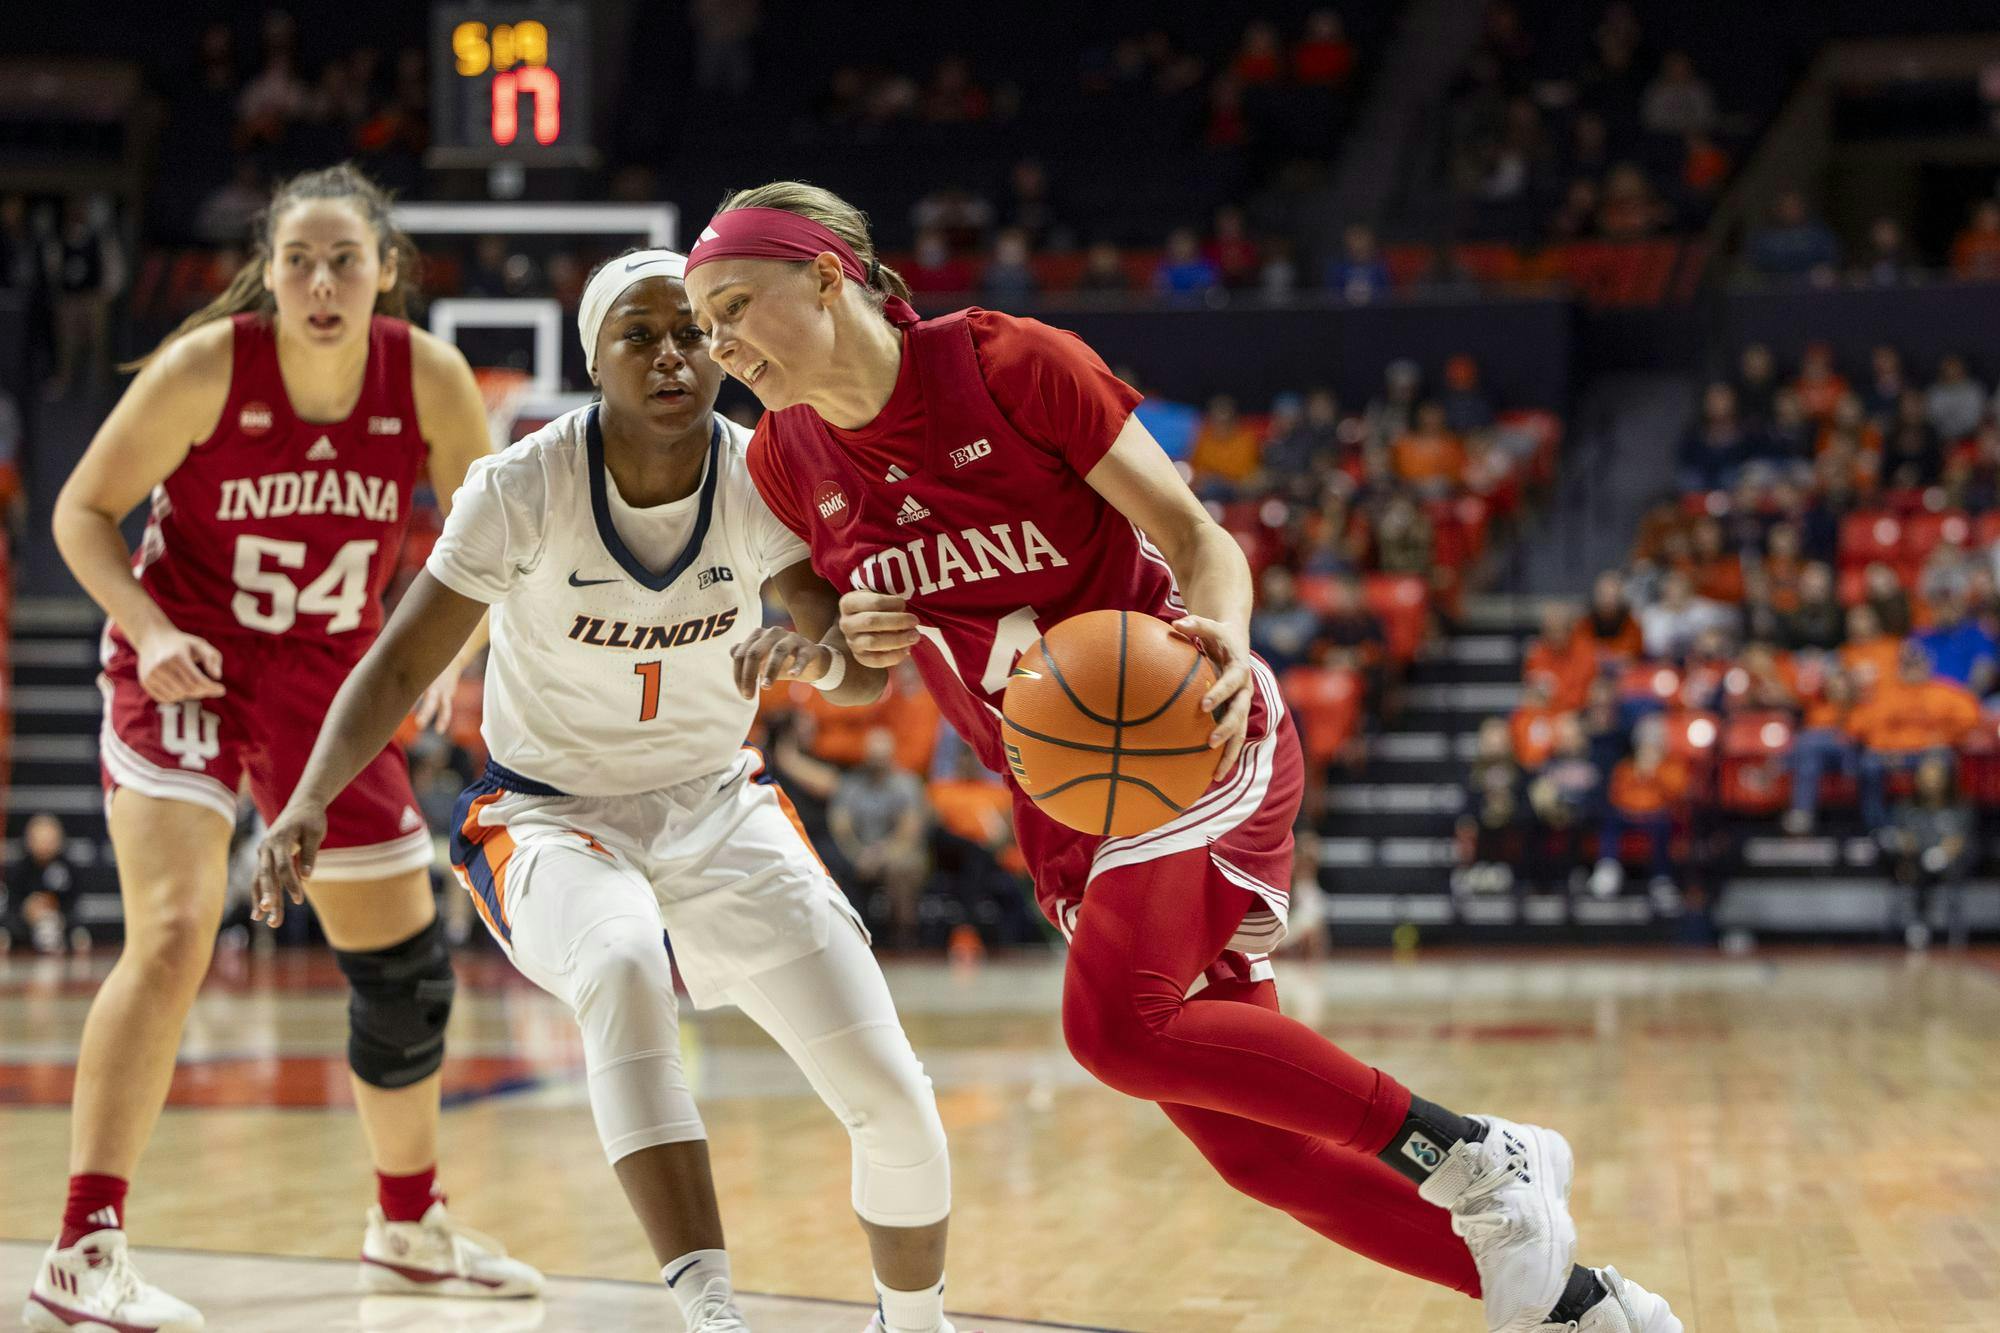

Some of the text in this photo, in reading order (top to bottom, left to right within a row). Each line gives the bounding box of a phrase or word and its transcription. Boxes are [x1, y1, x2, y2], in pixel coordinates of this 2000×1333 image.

[491, 65, 560, 146] 17
[950, 438, 992, 469] BIG
[215, 468, 399, 522] INDIANA
[818, 492, 846, 519] RMK
[896, 507, 931, 526] adidas
[231, 534, 379, 635] 54
[697, 566, 734, 590] BIG
[849, 520, 1069, 601] NDIANA
[568, 606, 740, 650] ILLINOIS
[634, 660, 662, 722] 1
